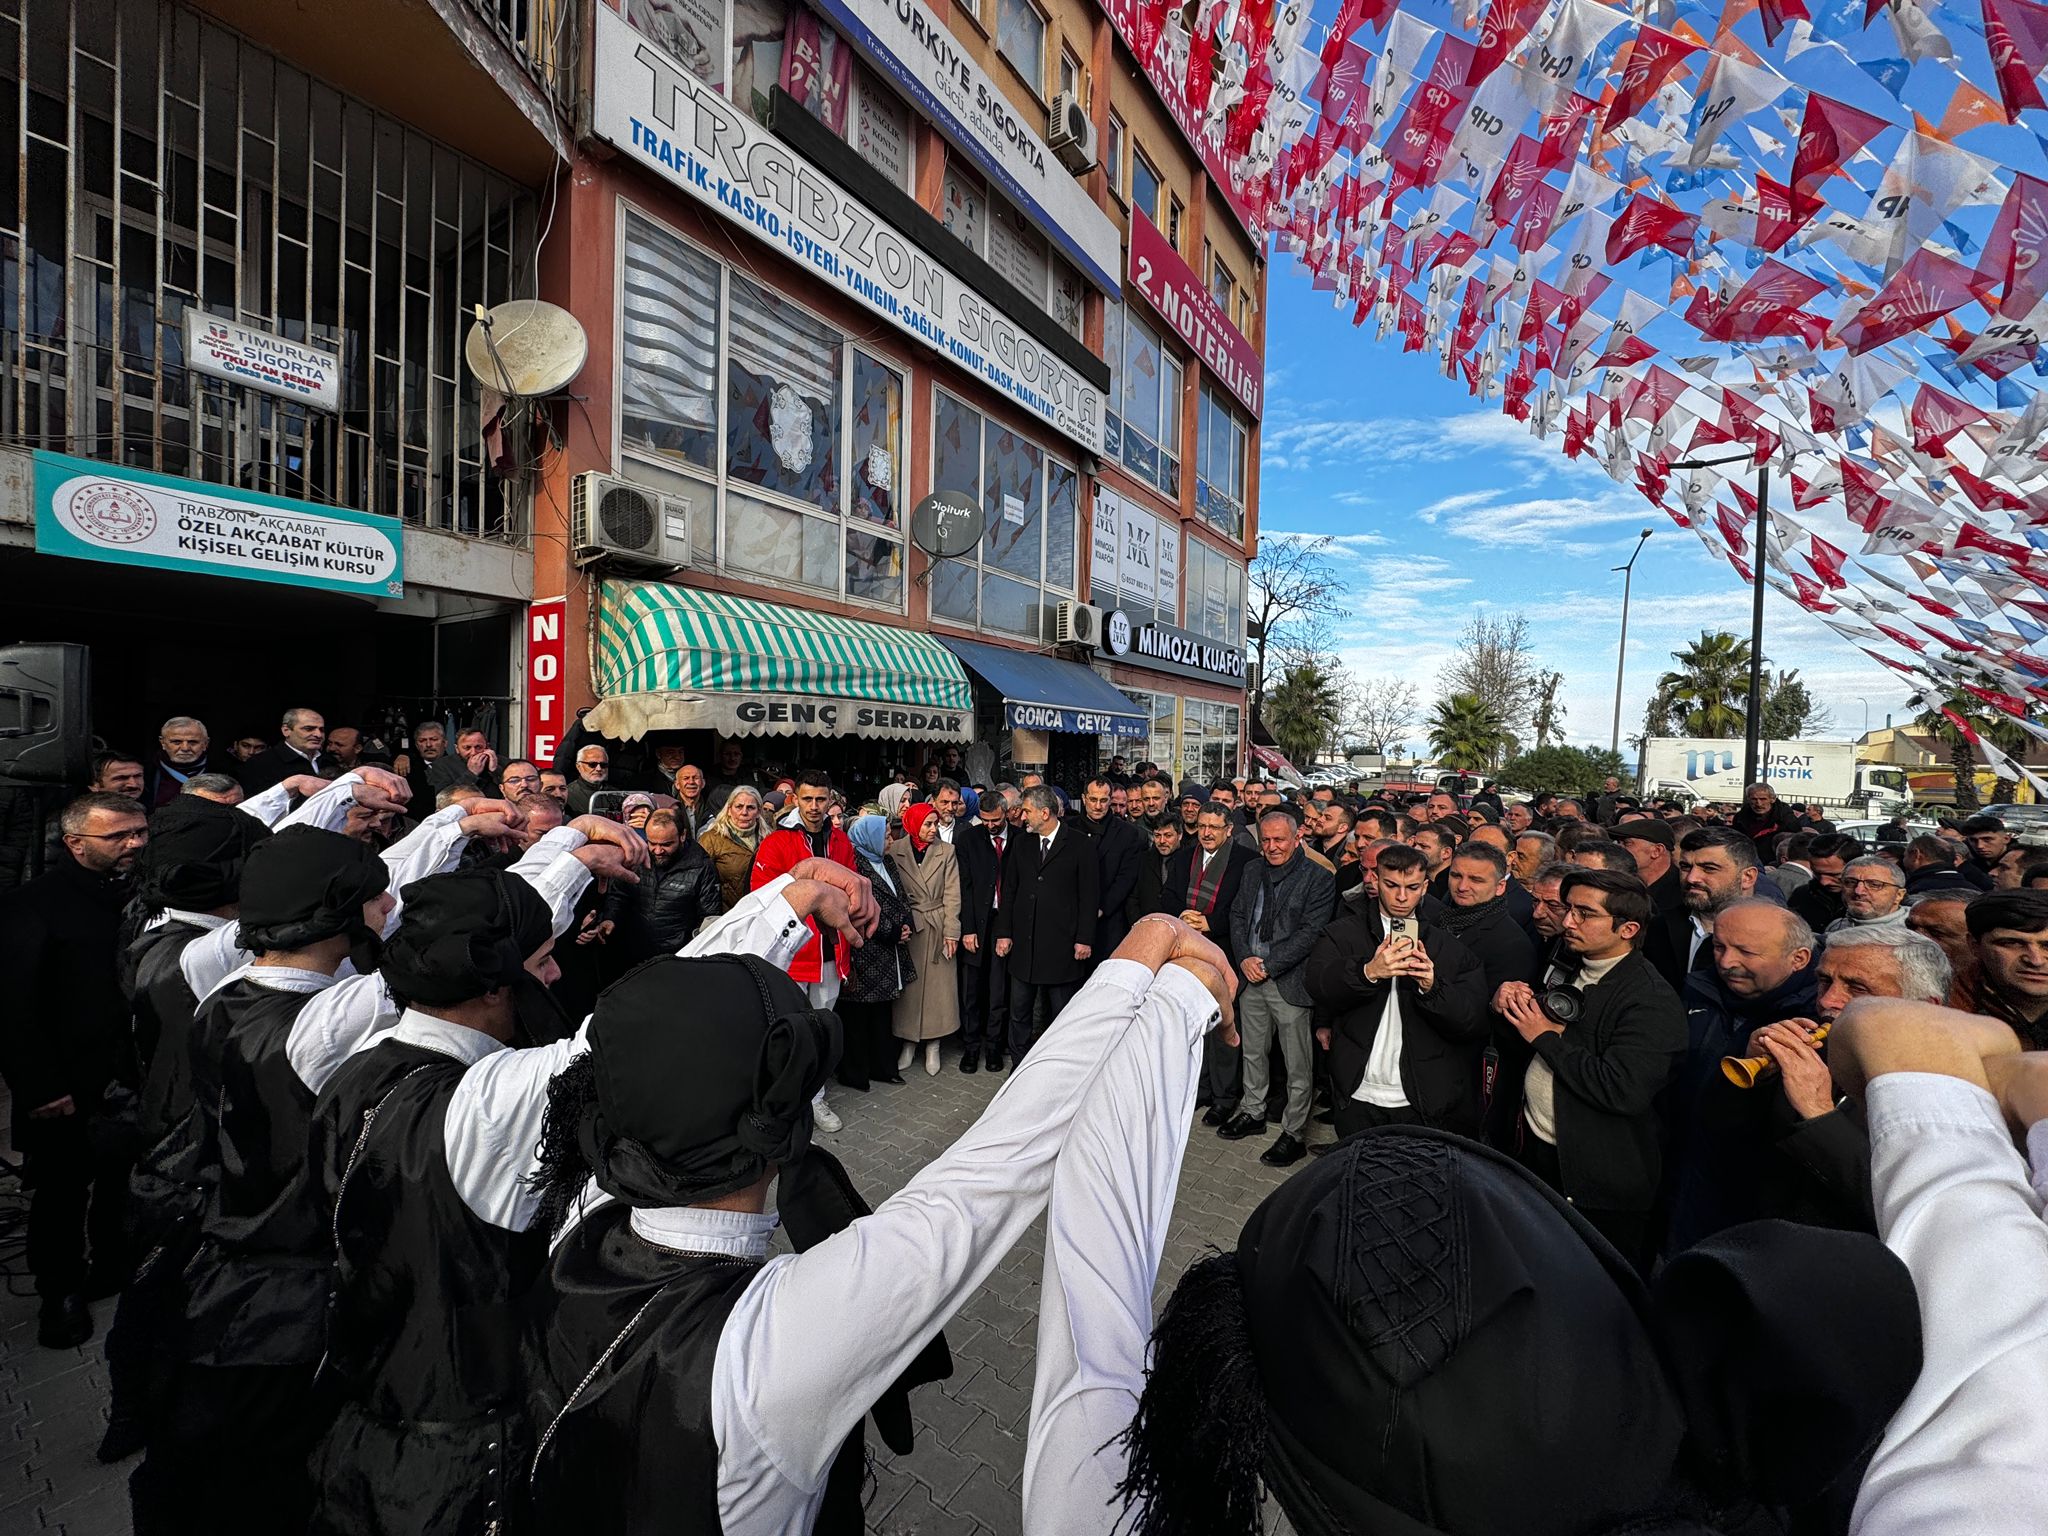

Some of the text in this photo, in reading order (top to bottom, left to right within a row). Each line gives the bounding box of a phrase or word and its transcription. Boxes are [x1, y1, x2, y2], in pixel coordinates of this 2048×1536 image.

[882, 0, 972, 95] ÜRKİYE
[866, 34, 900, 75] Trabzon
[900, 70, 931, 105] Sigorta
[934, 70, 1006, 158] Gücü, adında.
[1403, 128, 1428, 148] CHP
[1503, 172, 1523, 200] CHP
[1271, 202, 1289, 214] CHP
[634, 43, 1097, 427] TRABZON SİGORTA
[1740, 300, 1782, 314] CHP
[235, 330, 333, 370] TİMURLAR
[243, 346, 326, 382] SİGORTA
[211, 349, 322, 390] UTKU CAN ŞENER
[1604, 370, 1624, 383] HP
[177, 502, 247, 524] TRABZON
[258, 516, 327, 537] AKÇAABAT
[1875, 526, 1915, 541] CHP
[177, 515, 384, 562] ÖZEL AKÇAABAT KÜLTÜR
[178, 534, 375, 575] KİŞİSEL GELİŞİM KURSU
[1138, 622, 1247, 678] MİMOZA KUAFÖR
[736, 702, 962, 732] GENÇ SERDAR
[1014, 706, 1063, 728] GONCA
[1756, 755, 1814, 767] URAT
[1756, 766, 1813, 780] OJİSTİK
